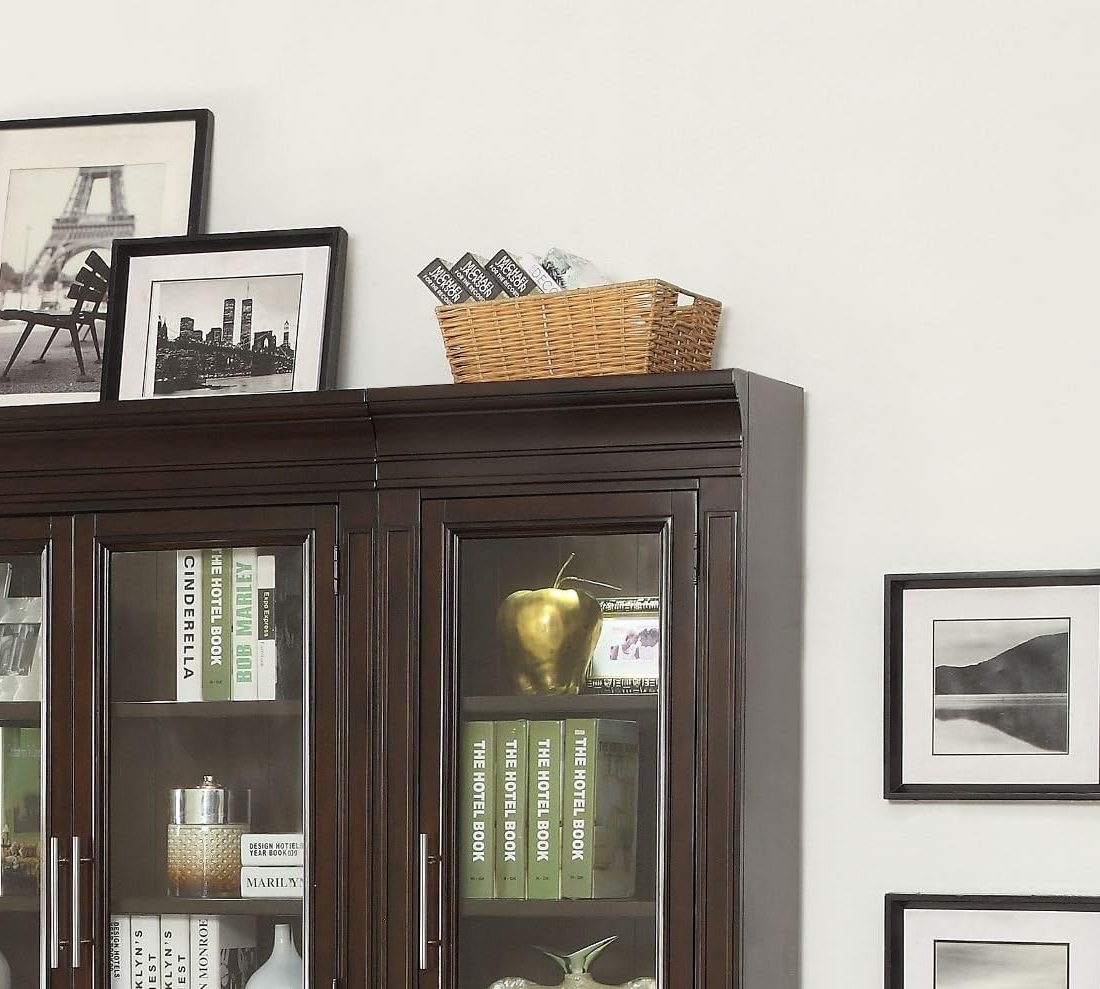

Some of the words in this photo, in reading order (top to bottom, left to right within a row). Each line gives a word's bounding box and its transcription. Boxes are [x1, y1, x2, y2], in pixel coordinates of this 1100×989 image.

[423, 274, 433, 284] FOR
[429, 271, 460, 302] JACKSON
[434, 265, 462, 297] MICHAEL
[455, 270, 464, 280] FOR
[460, 266, 492, 298] JACKSON
[465, 260, 494, 293] MICHAEL
[489, 264, 499, 275] FOR
[495, 261, 526, 293] JACKSON
[500, 255, 529, 288] MICHAEL
[183, 555, 195, 679] CINDERELLA
[210, 577, 223, 624] HOTEL
[235, 562, 253, 636] MARLEY
[210, 626, 223, 666] BOOK
[473, 740, 486, 769] THE
[505, 739, 517, 768] THE
[537, 739, 550, 768] THE
[574, 737, 587, 767] THE
[473, 772, 485, 818] HOTEL
[504, 771, 516, 818] HOTEL
[537, 770, 550, 818] HOTEL
[573, 769, 586, 817] HOTEL
[472, 821, 485, 862] BOOK
[504, 820, 516, 862] BOOK
[536, 820, 549, 862] BOOK
[571, 819, 584, 861] BOOK
[199, 919, 209, 979] MONROE
